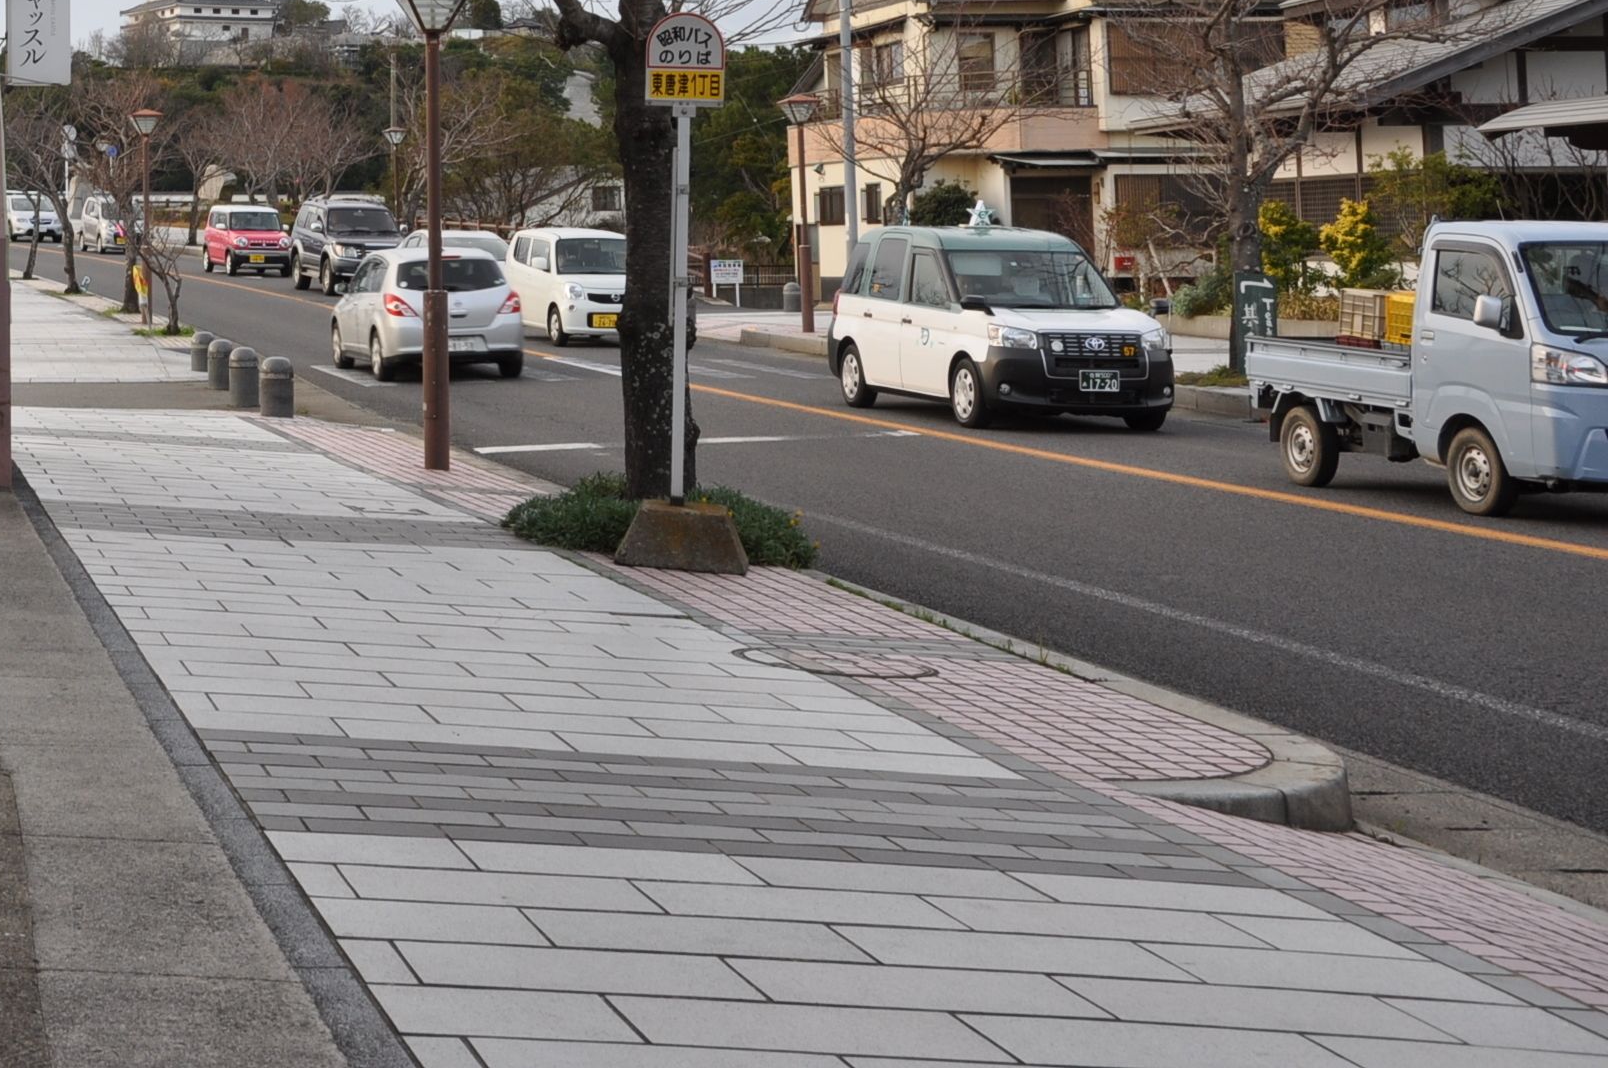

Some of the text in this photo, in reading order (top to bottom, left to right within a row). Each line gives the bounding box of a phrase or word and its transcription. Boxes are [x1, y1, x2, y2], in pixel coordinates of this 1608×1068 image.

[656, 25, 713, 49] 昭和バス
[659, 49, 712, 65] のりば
[1123, 346, 1135, 356] 57
